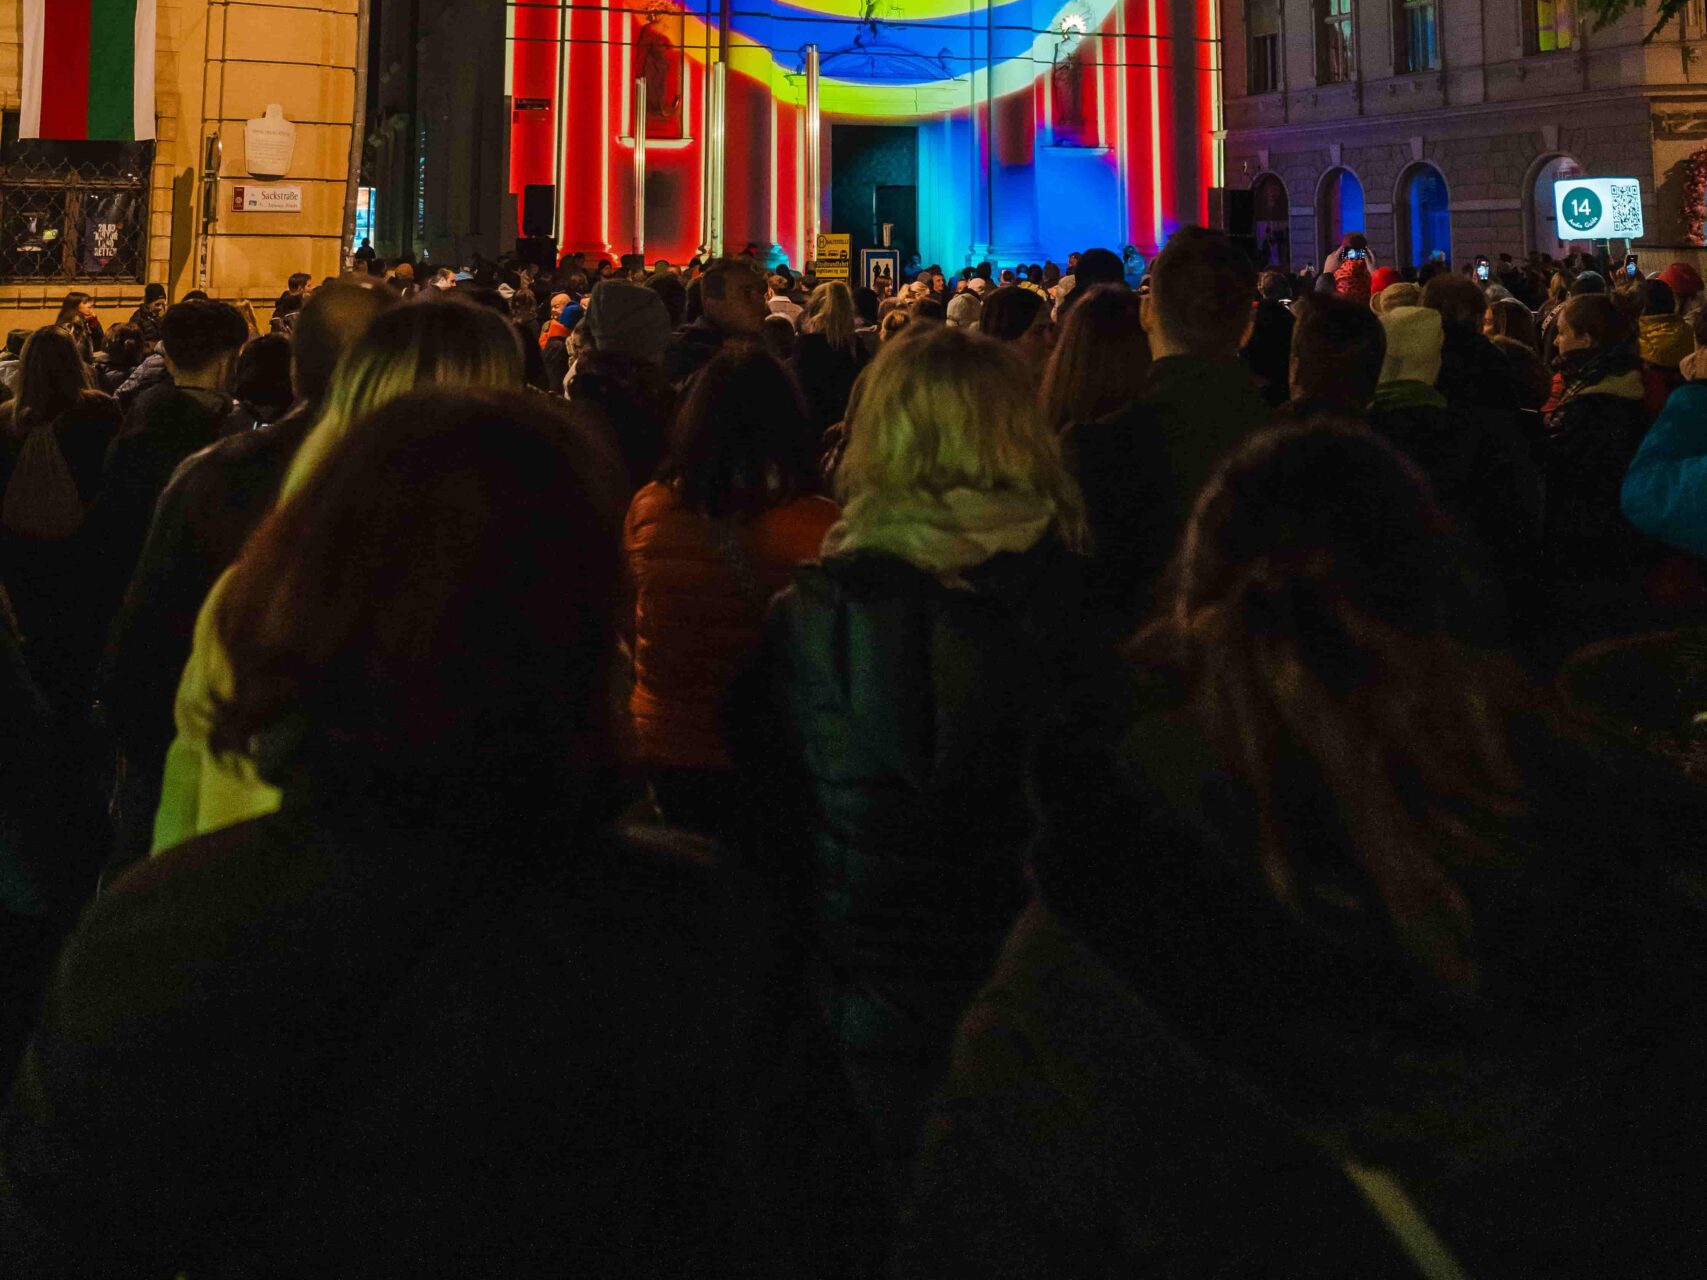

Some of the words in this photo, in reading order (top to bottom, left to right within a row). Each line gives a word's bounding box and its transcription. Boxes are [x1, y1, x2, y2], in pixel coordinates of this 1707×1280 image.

[261, 191, 298, 201] Sackstraße
[1571, 198, 1592, 216] 14
[1568, 218, 1583, 229] Audio
[1584, 217, 1598, 228] Guide
